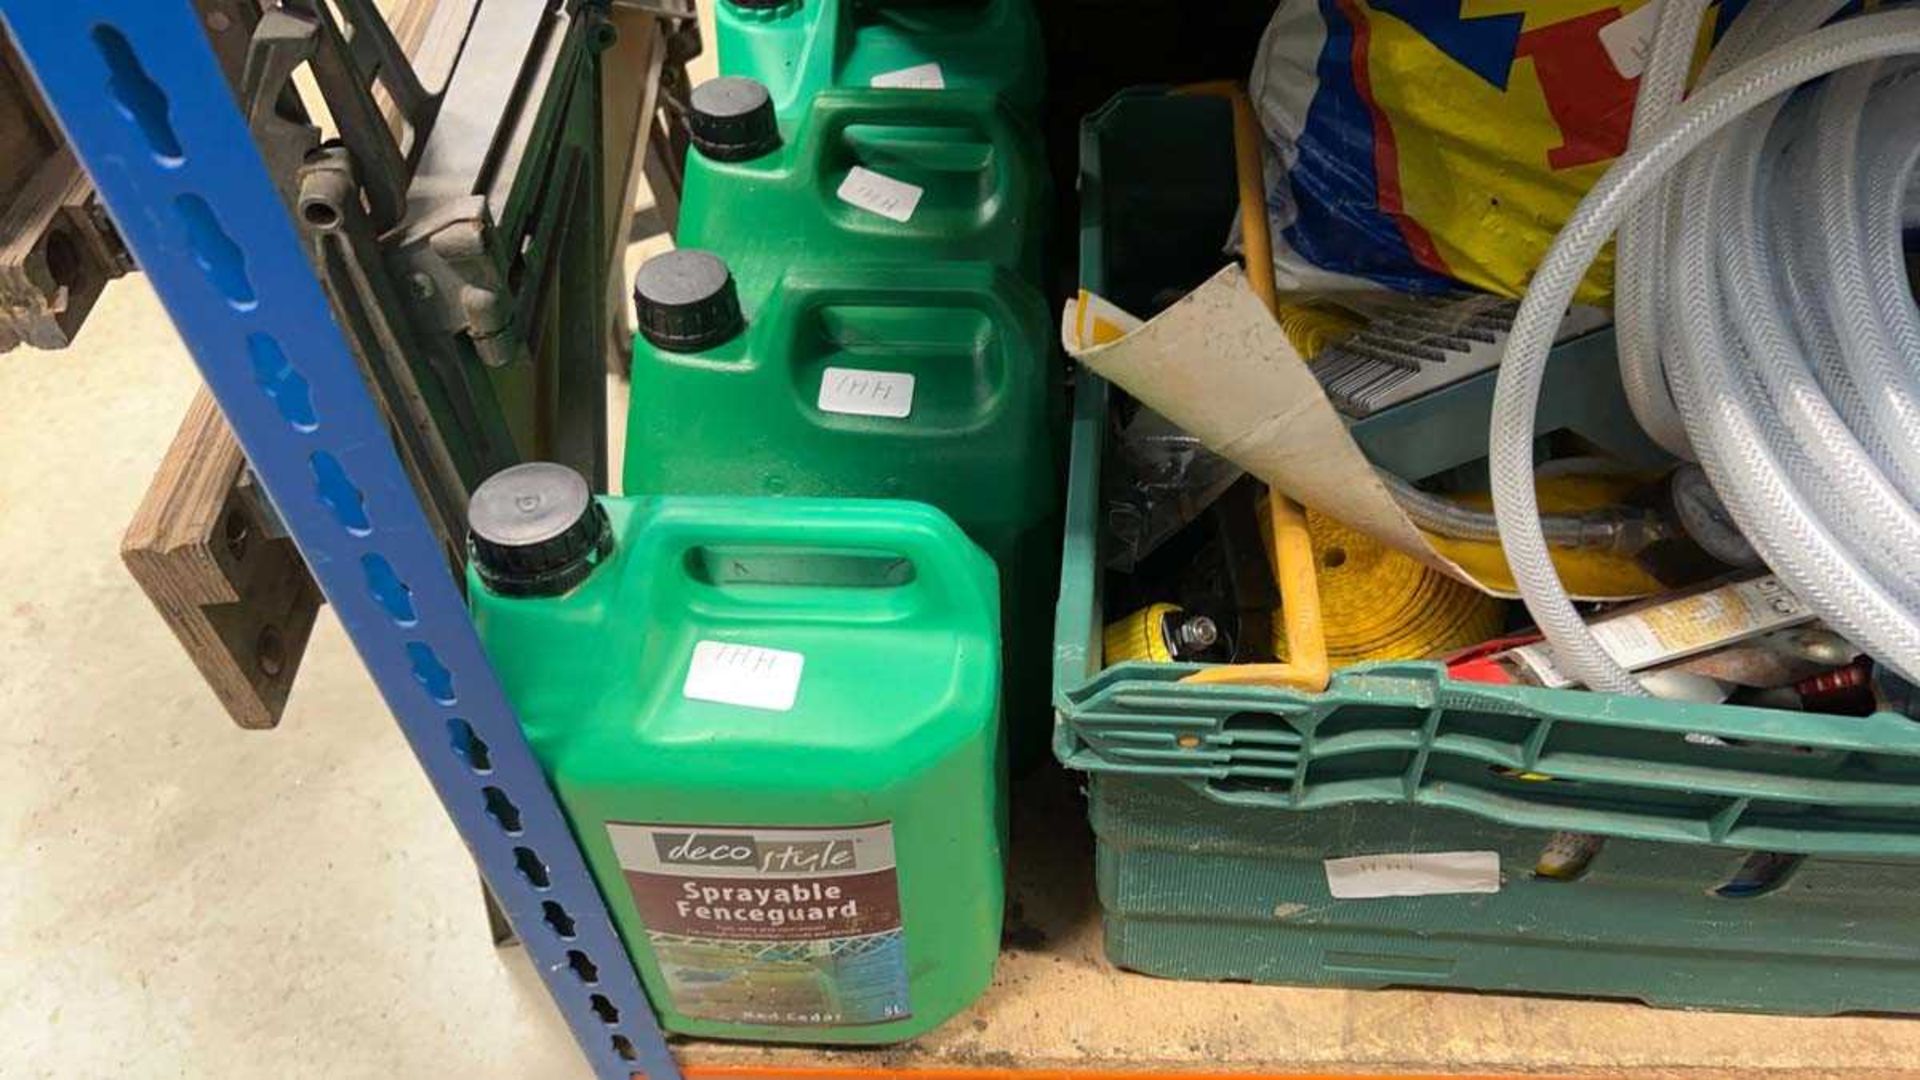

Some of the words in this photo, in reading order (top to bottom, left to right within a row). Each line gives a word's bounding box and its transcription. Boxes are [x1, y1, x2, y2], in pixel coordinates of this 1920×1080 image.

[668, 832, 751, 860] deco
[760, 840, 850, 872] style
[682, 881, 842, 906] Sprayable
[677, 900, 858, 925] Fenceguard
